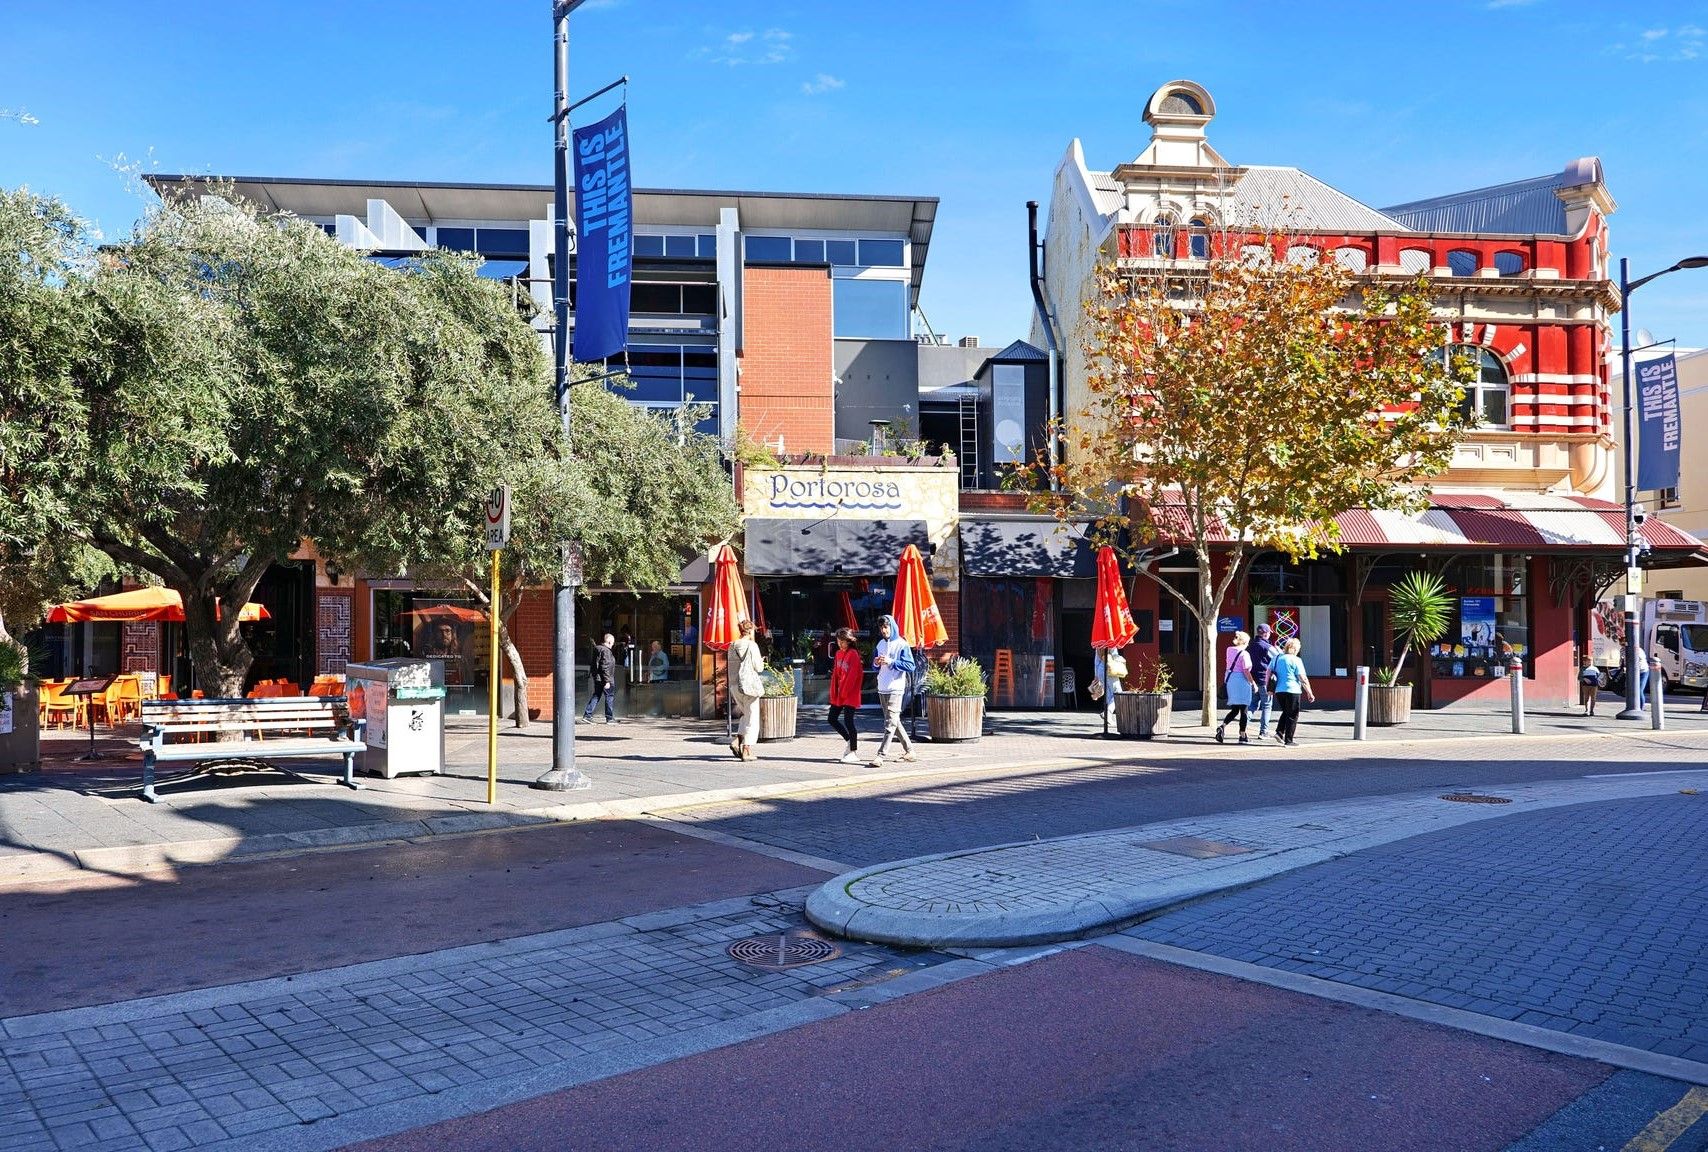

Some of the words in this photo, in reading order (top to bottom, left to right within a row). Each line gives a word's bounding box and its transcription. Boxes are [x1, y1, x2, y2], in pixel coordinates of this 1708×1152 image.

[579, 133, 605, 166] IS
[582, 173, 606, 238] THIS
[606, 119, 629, 289] FREMANTLE
[1640, 364, 1661, 383] IS
[1642, 385, 1663, 422] THIS
[1661, 360, 1679, 451] FREMANTLE
[770, 474, 900, 500] Portorosa
